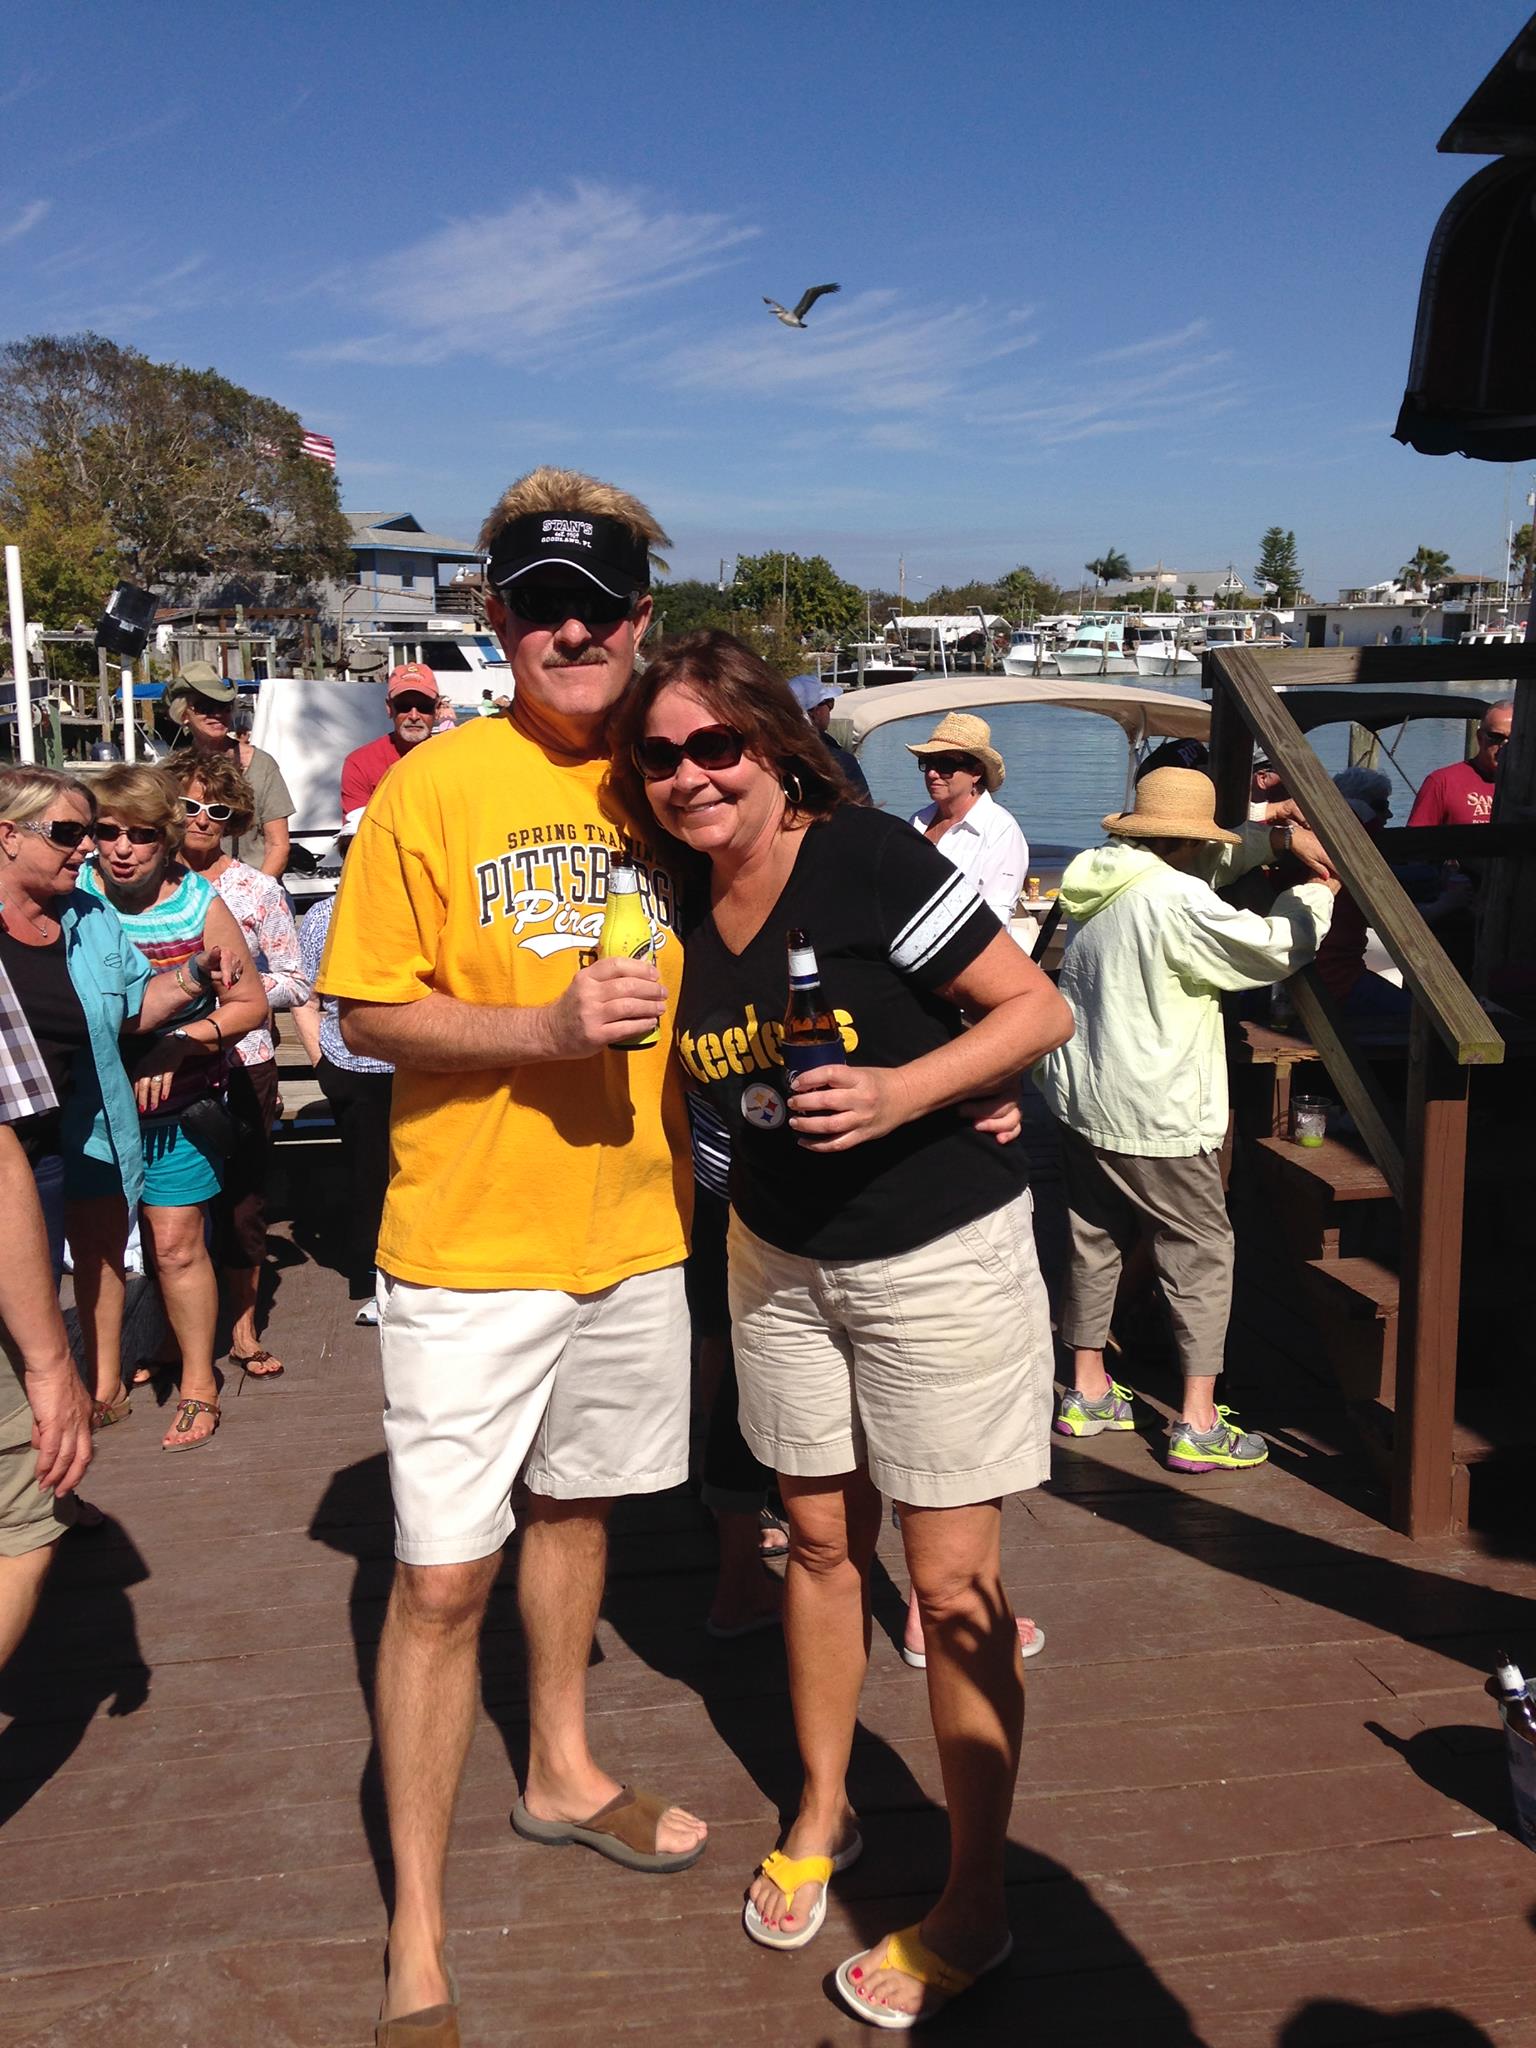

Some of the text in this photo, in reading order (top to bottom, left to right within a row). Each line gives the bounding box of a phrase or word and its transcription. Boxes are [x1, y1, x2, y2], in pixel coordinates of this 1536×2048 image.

[543, 520, 593, 535] STAN'S
[507, 823, 578, 850] SPRING
[475, 844, 684, 938] PITTSBRG
[677, 1003, 859, 1084] teeles
